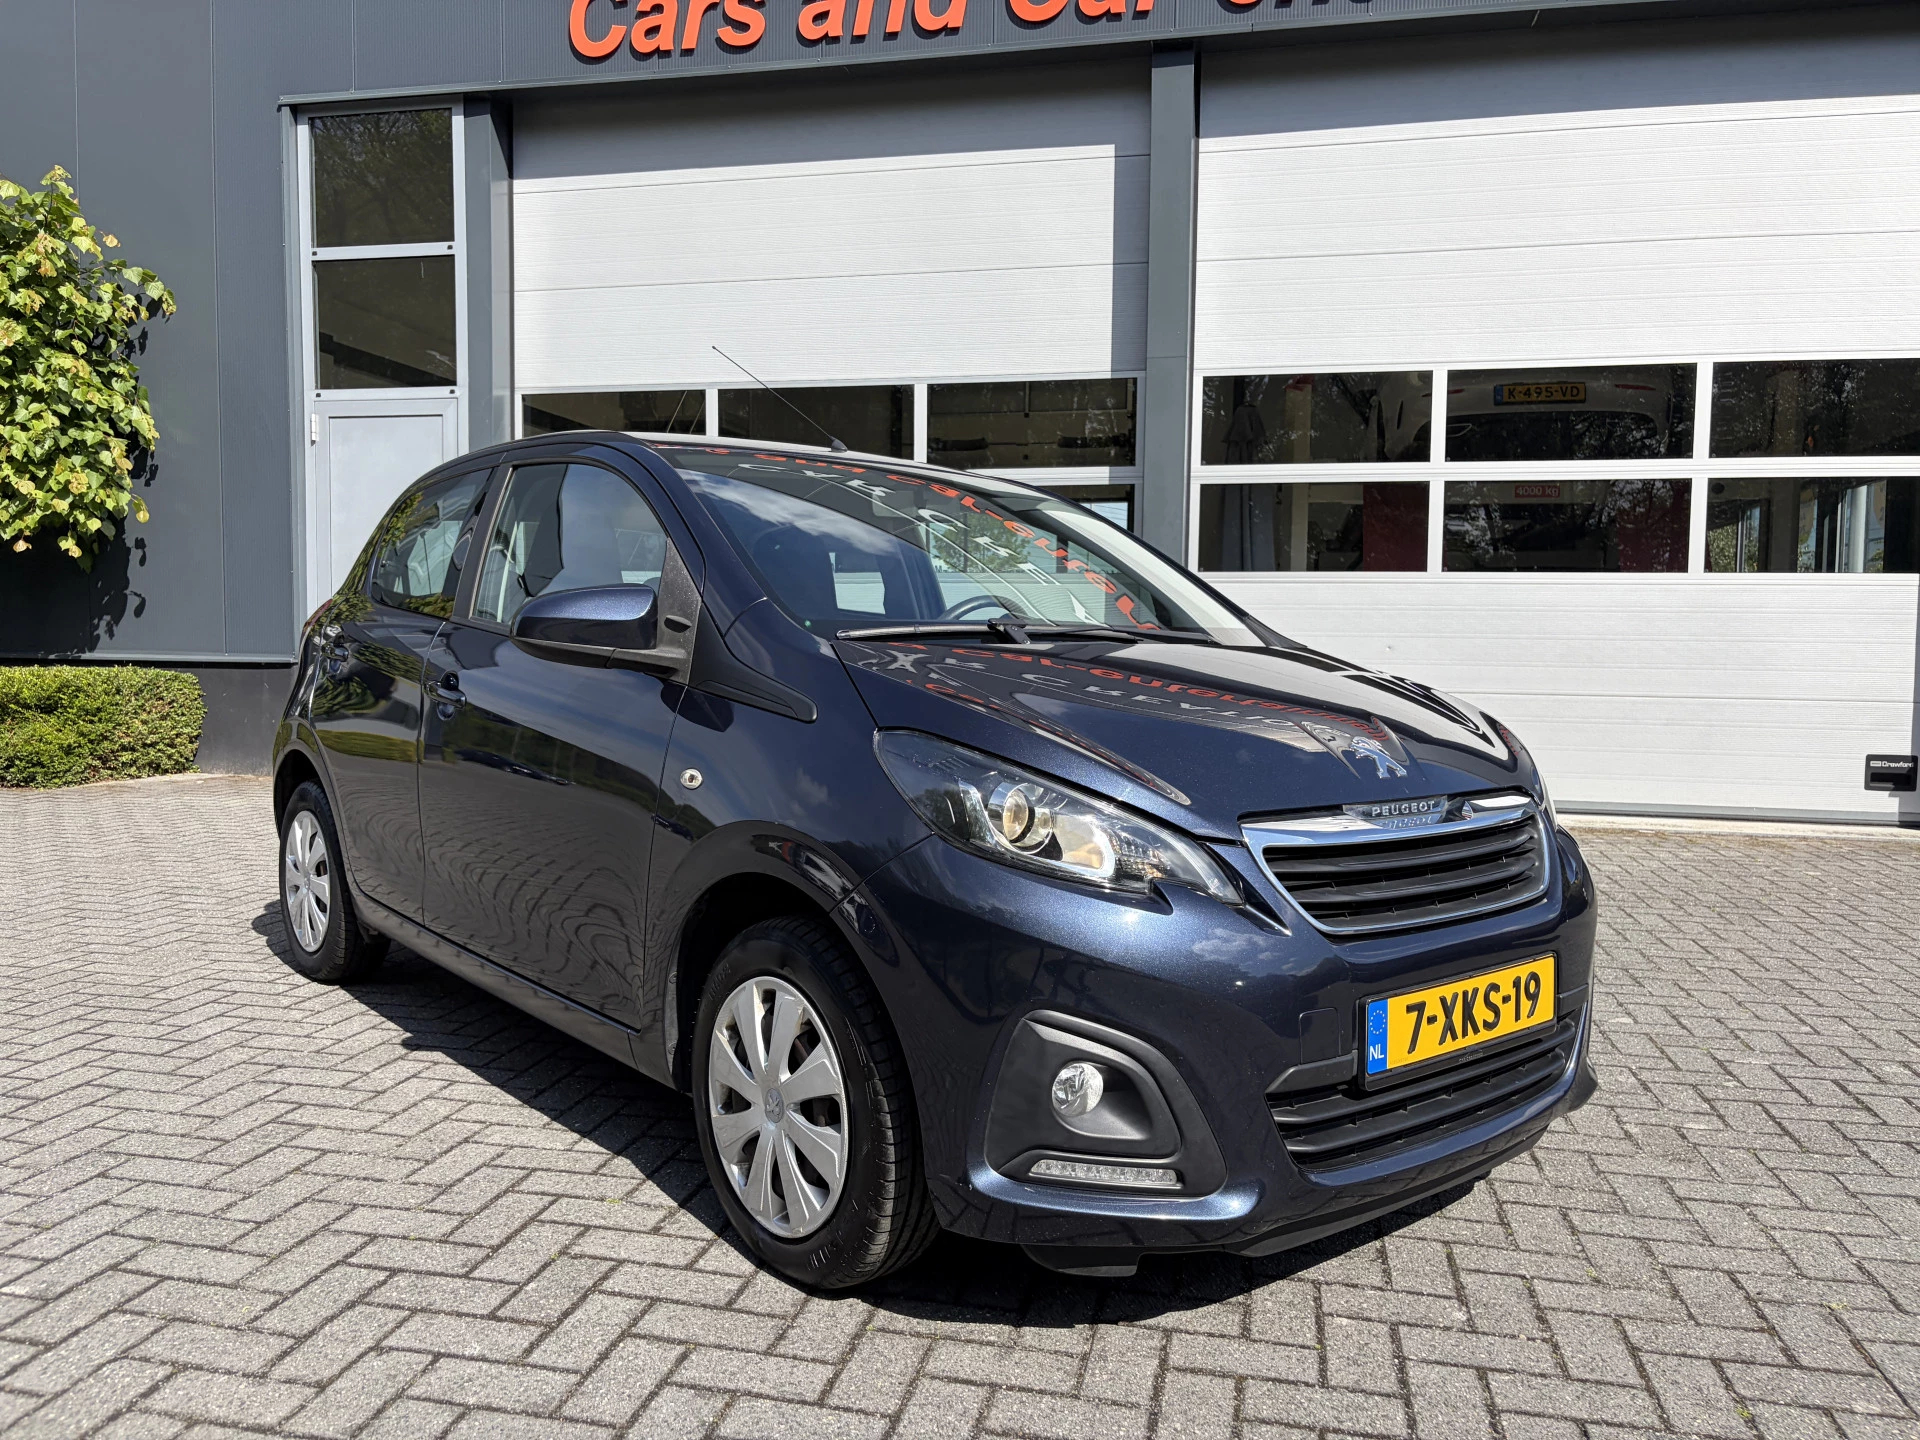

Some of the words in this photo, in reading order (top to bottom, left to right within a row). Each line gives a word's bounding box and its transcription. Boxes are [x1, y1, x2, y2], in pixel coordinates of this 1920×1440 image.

[569, 0, 766, 58] Cars
[1507, 385, 1580, 400] K-495-VD
[1516, 486, 1542, 496] 4000
[1881, 760, 1914, 768] Crawford
[1371, 800, 1435, 817] PEUGEOT
[1405, 970, 1542, 1055] 7-XKS-19
[1369, 1043, 1385, 1061] NL
